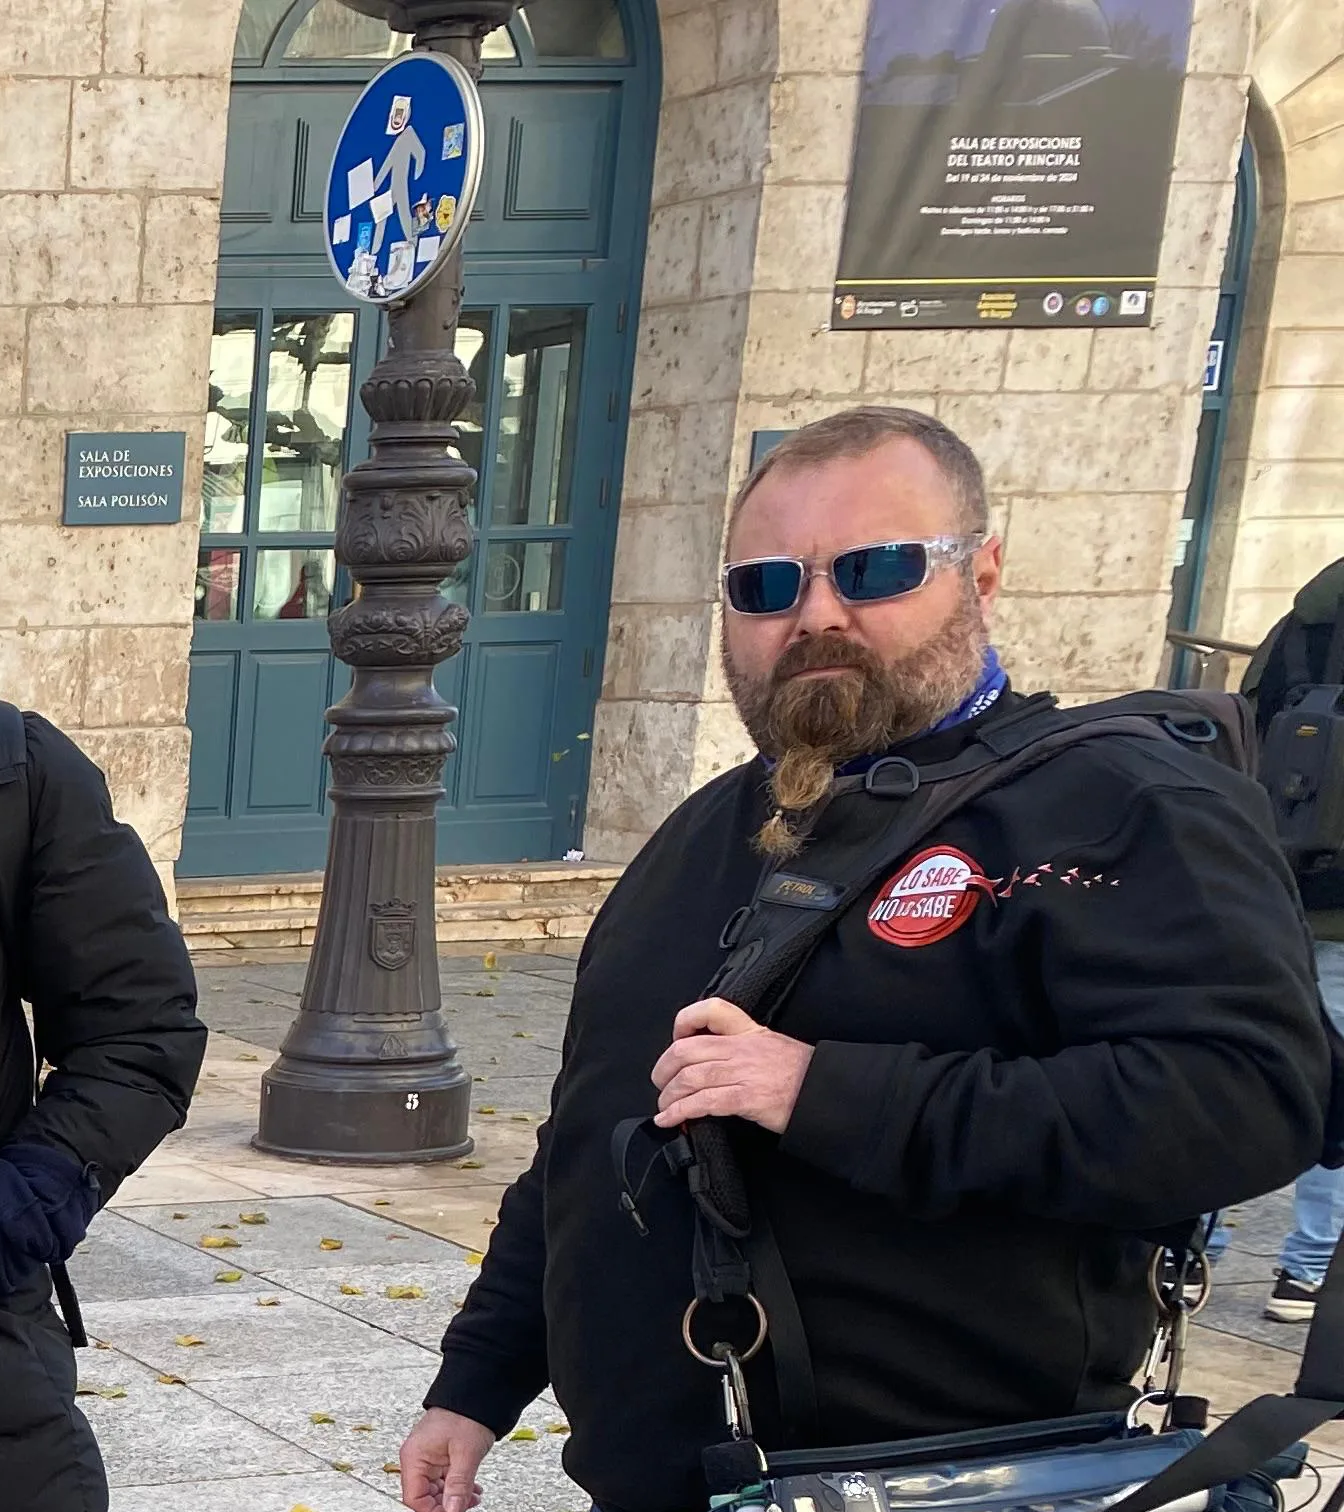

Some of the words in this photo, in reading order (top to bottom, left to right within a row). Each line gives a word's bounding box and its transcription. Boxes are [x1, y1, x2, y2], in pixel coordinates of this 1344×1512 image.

[950, 137, 979, 150] SALA
[980, 137, 998, 150] DE
[998, 136, 1082, 150] EXPOSICIONES
[947, 154, 969, 167] DEL
[971, 154, 1015, 167] TEATRO
[1016, 153, 1081, 167] PRINCIPAL
[79, 450, 109, 463] SALA
[113, 450, 130, 462] DE
[78, 465, 174, 478] EXPOSICIONES
[78, 496, 108, 508] SALA
[111, 492, 168, 507] POLISÓN
[900, 869, 923, 890] LO
[921, 867, 968, 888] SABE
[868, 898, 901, 921] NO
[911, 895, 957, 918] SABE
[405, 1093, 419, 1110] 5
